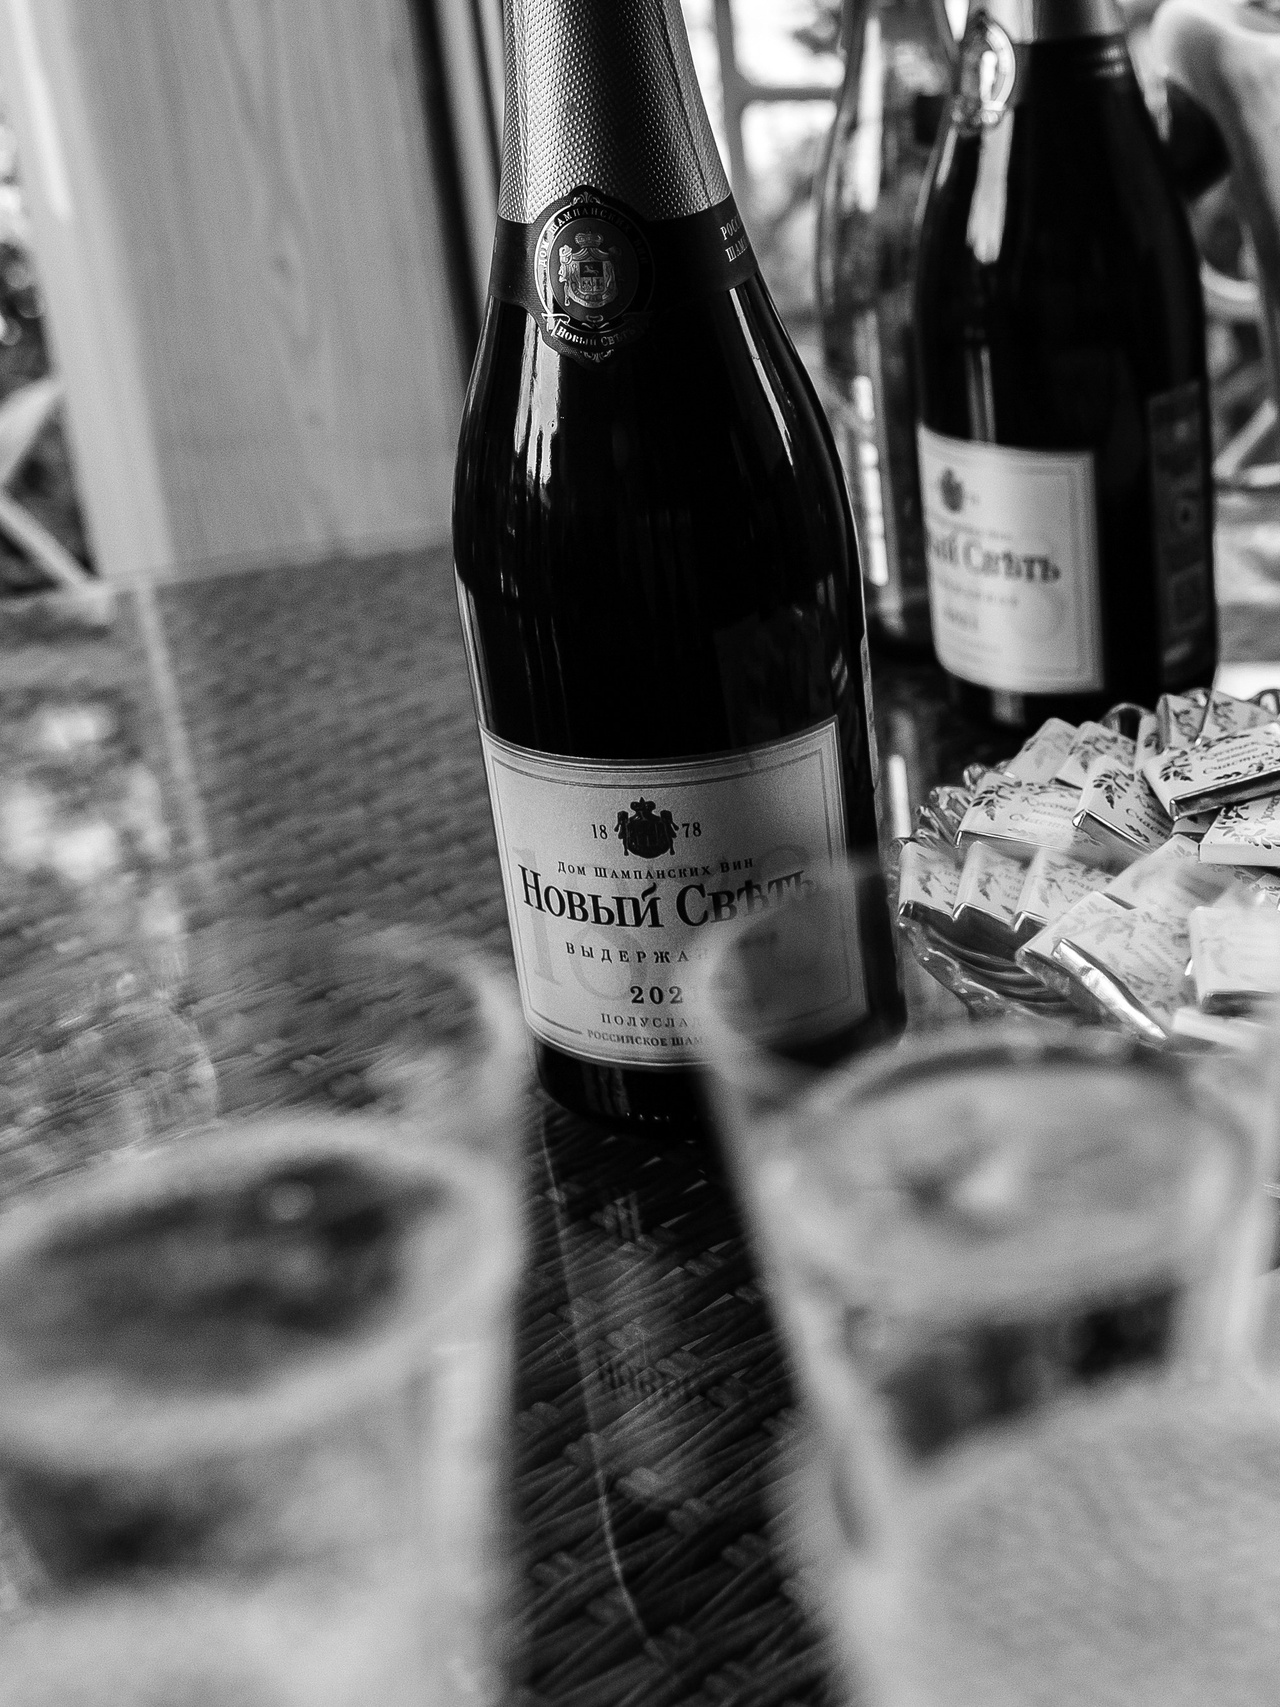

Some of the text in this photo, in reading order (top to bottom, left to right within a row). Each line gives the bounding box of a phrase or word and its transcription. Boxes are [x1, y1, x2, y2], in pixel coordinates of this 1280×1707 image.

[591, 822, 702, 840] 18 78
[518, 863, 665, 928] Новый
[565, 941, 708, 964] ВЫДЕРЖА
